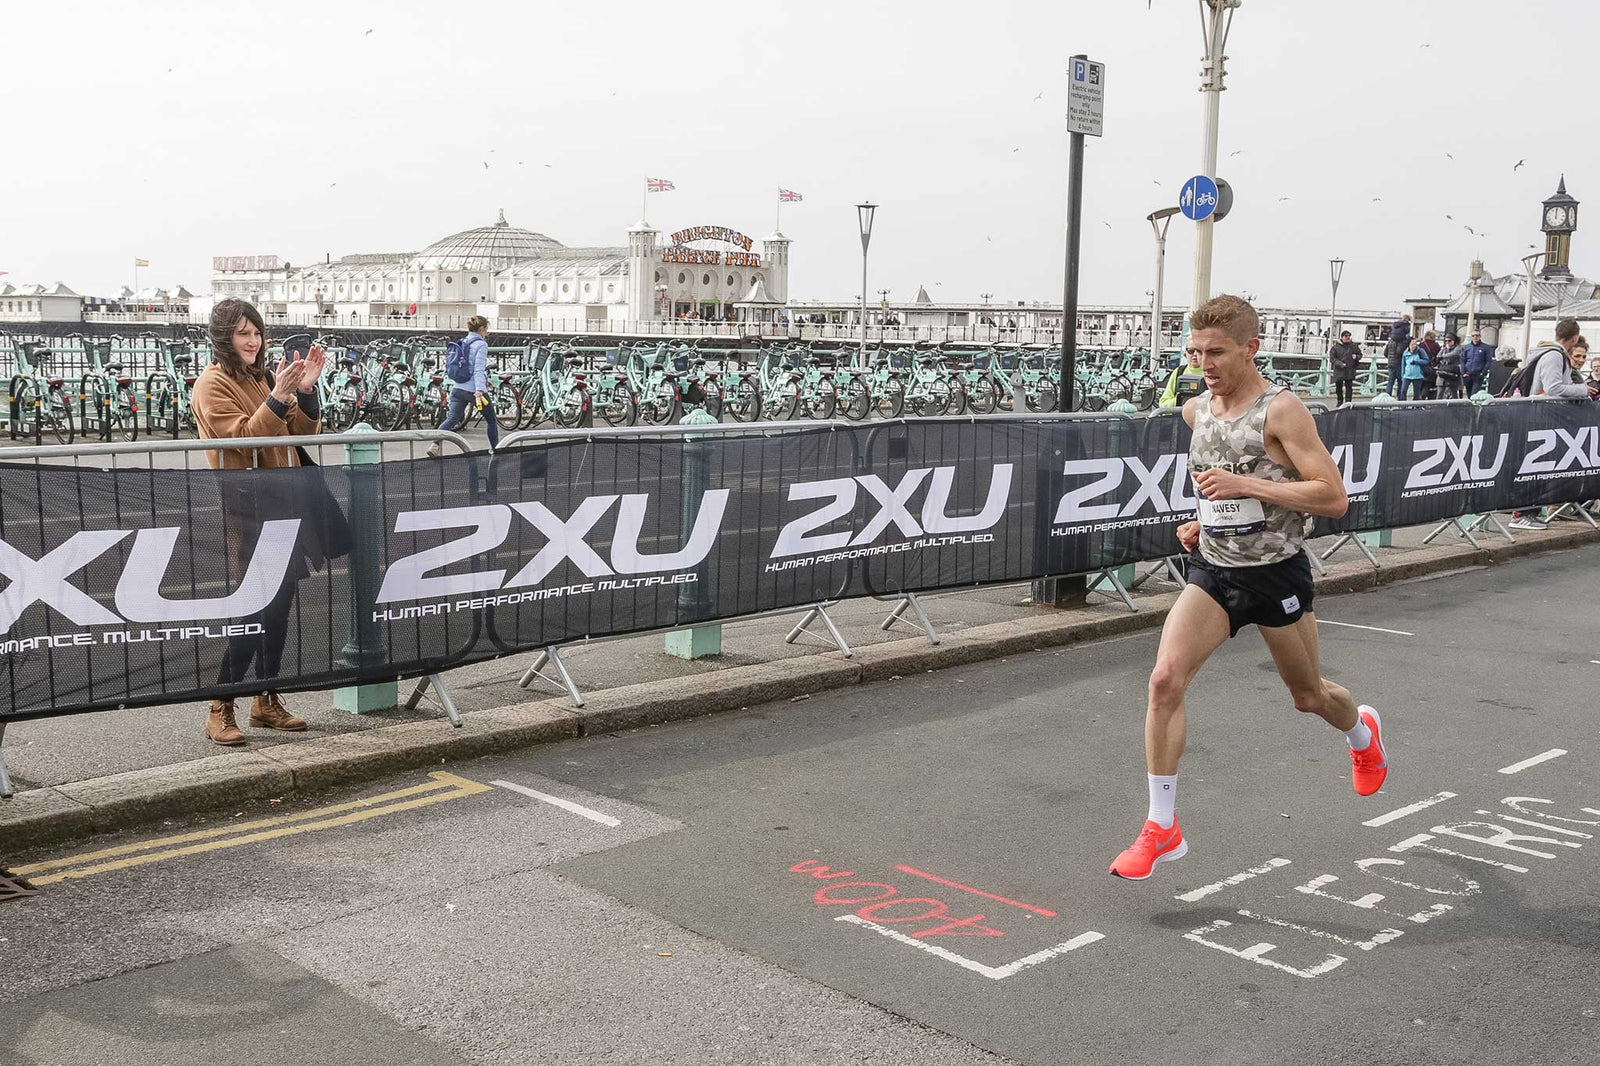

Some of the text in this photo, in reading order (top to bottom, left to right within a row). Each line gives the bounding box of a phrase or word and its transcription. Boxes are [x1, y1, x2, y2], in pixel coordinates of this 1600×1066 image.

[662, 247, 762, 267] PALACE PIER
[671, 225, 754, 252] BRIGHTON
[1404, 433, 1510, 489] 2XU
[1517, 426, 1600, 475] 2X
[770, 463, 1014, 559] 2XU
[1051, 525, 1093, 537] HUMAN
[376, 488, 731, 604] 2XU
[764, 533, 995, 573] HUMAN PERFORMANCE. MULTIPLIED.
[0, 518, 302, 635] XU
[372, 573, 699, 623] HUMAN PERFORMANCE. MULTIPLIED.
[103, 623, 266, 644] MULTIPLIED.
